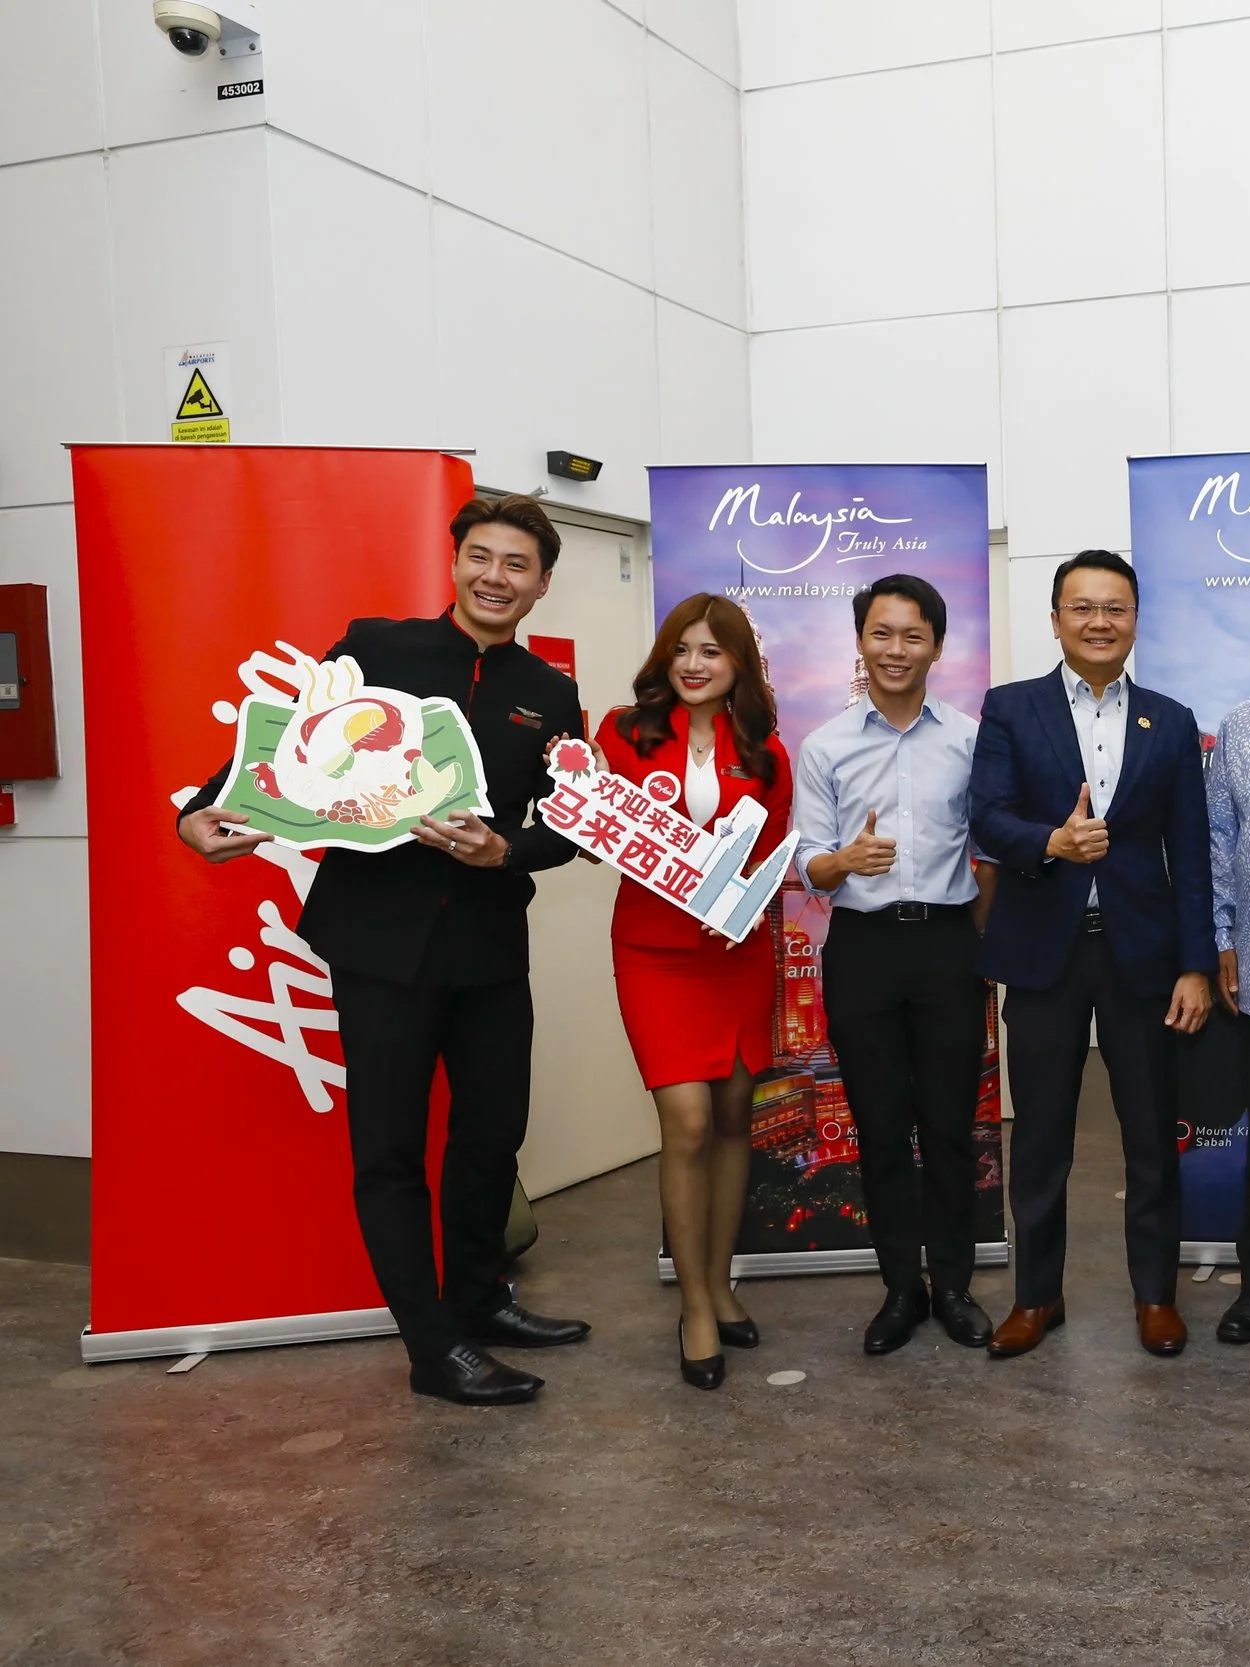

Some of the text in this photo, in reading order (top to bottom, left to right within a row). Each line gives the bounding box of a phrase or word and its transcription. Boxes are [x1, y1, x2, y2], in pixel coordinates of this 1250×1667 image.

[221, 82, 260, 97] 453002
[708, 483, 913, 574] Malaysia
[837, 531, 928, 553] Truly Asia
[591, 775, 701, 854] 欢迎来到
[540, 783, 704, 905] 马来西亚
[1195, 1126, 1249, 1137] Mount Ki
[1195, 1137, 1232, 1147] Sabah
